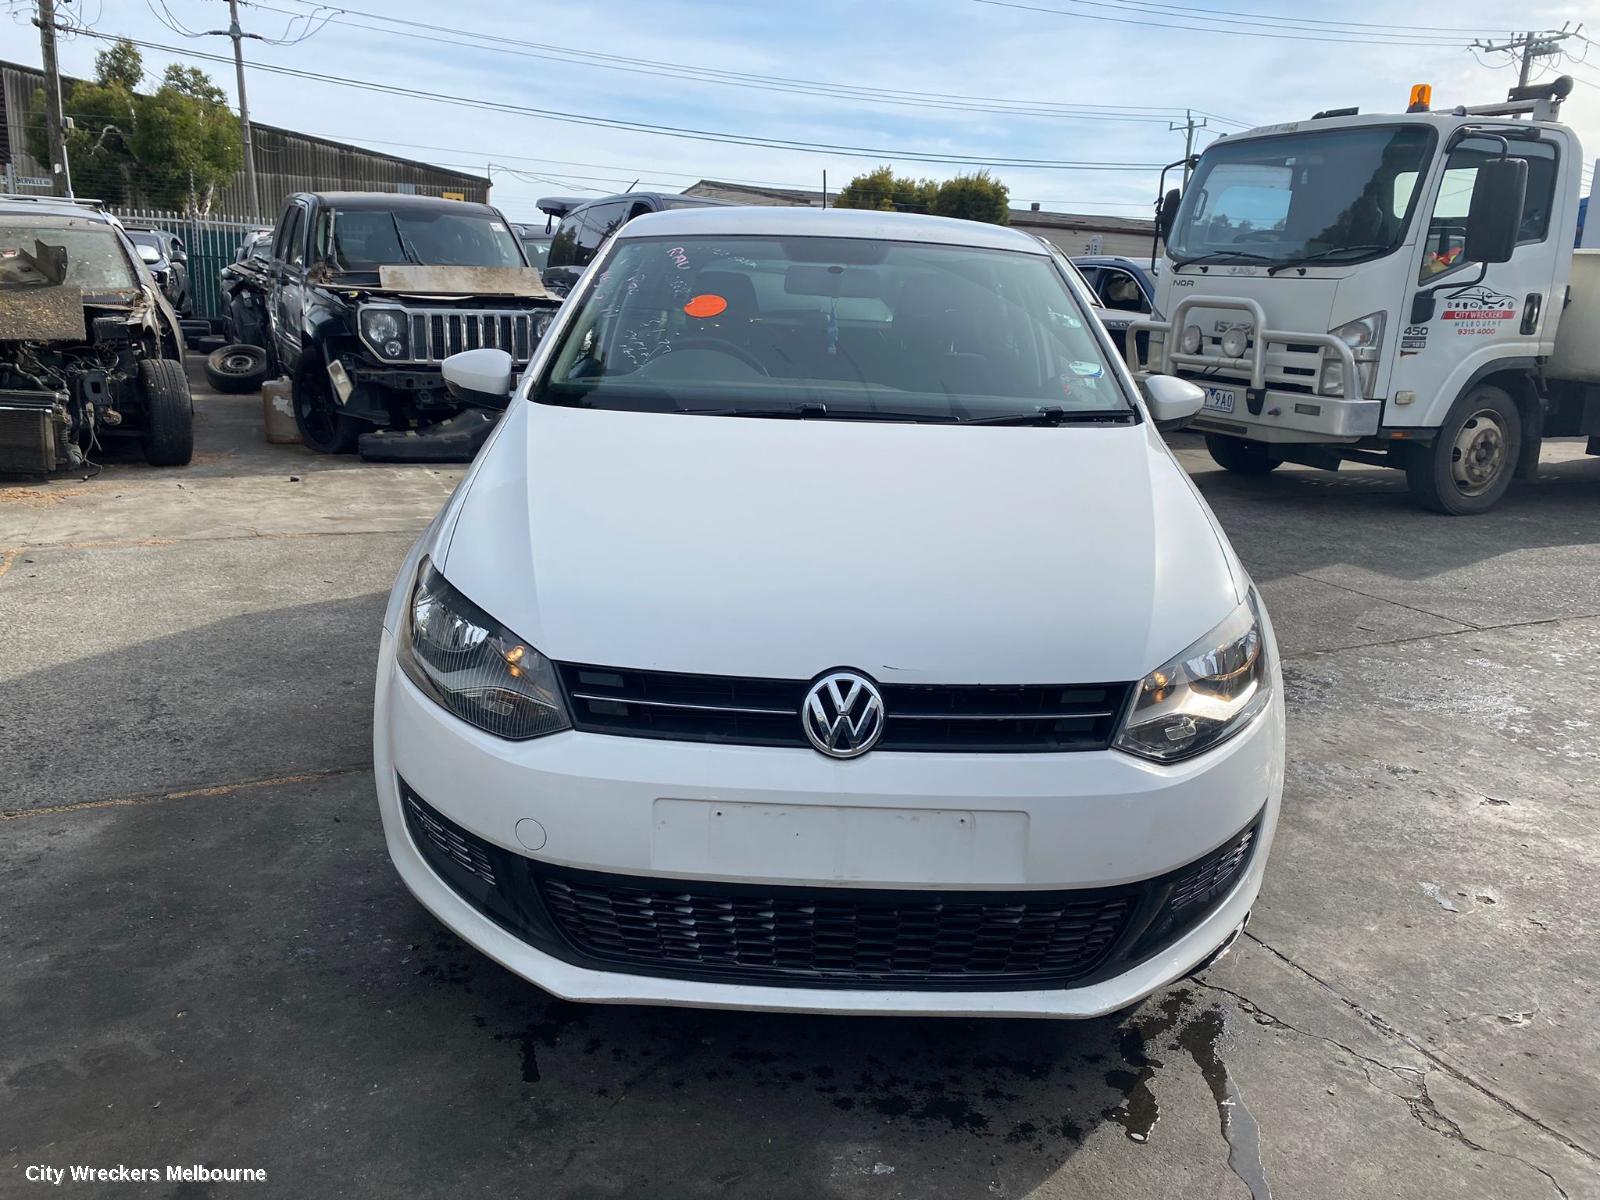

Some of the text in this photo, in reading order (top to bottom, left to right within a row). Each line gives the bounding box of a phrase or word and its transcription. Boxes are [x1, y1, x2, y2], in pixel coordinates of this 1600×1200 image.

[1454, 311, 1504, 319] CITY WRECKERS
[1403, 326, 1429, 336] 450
